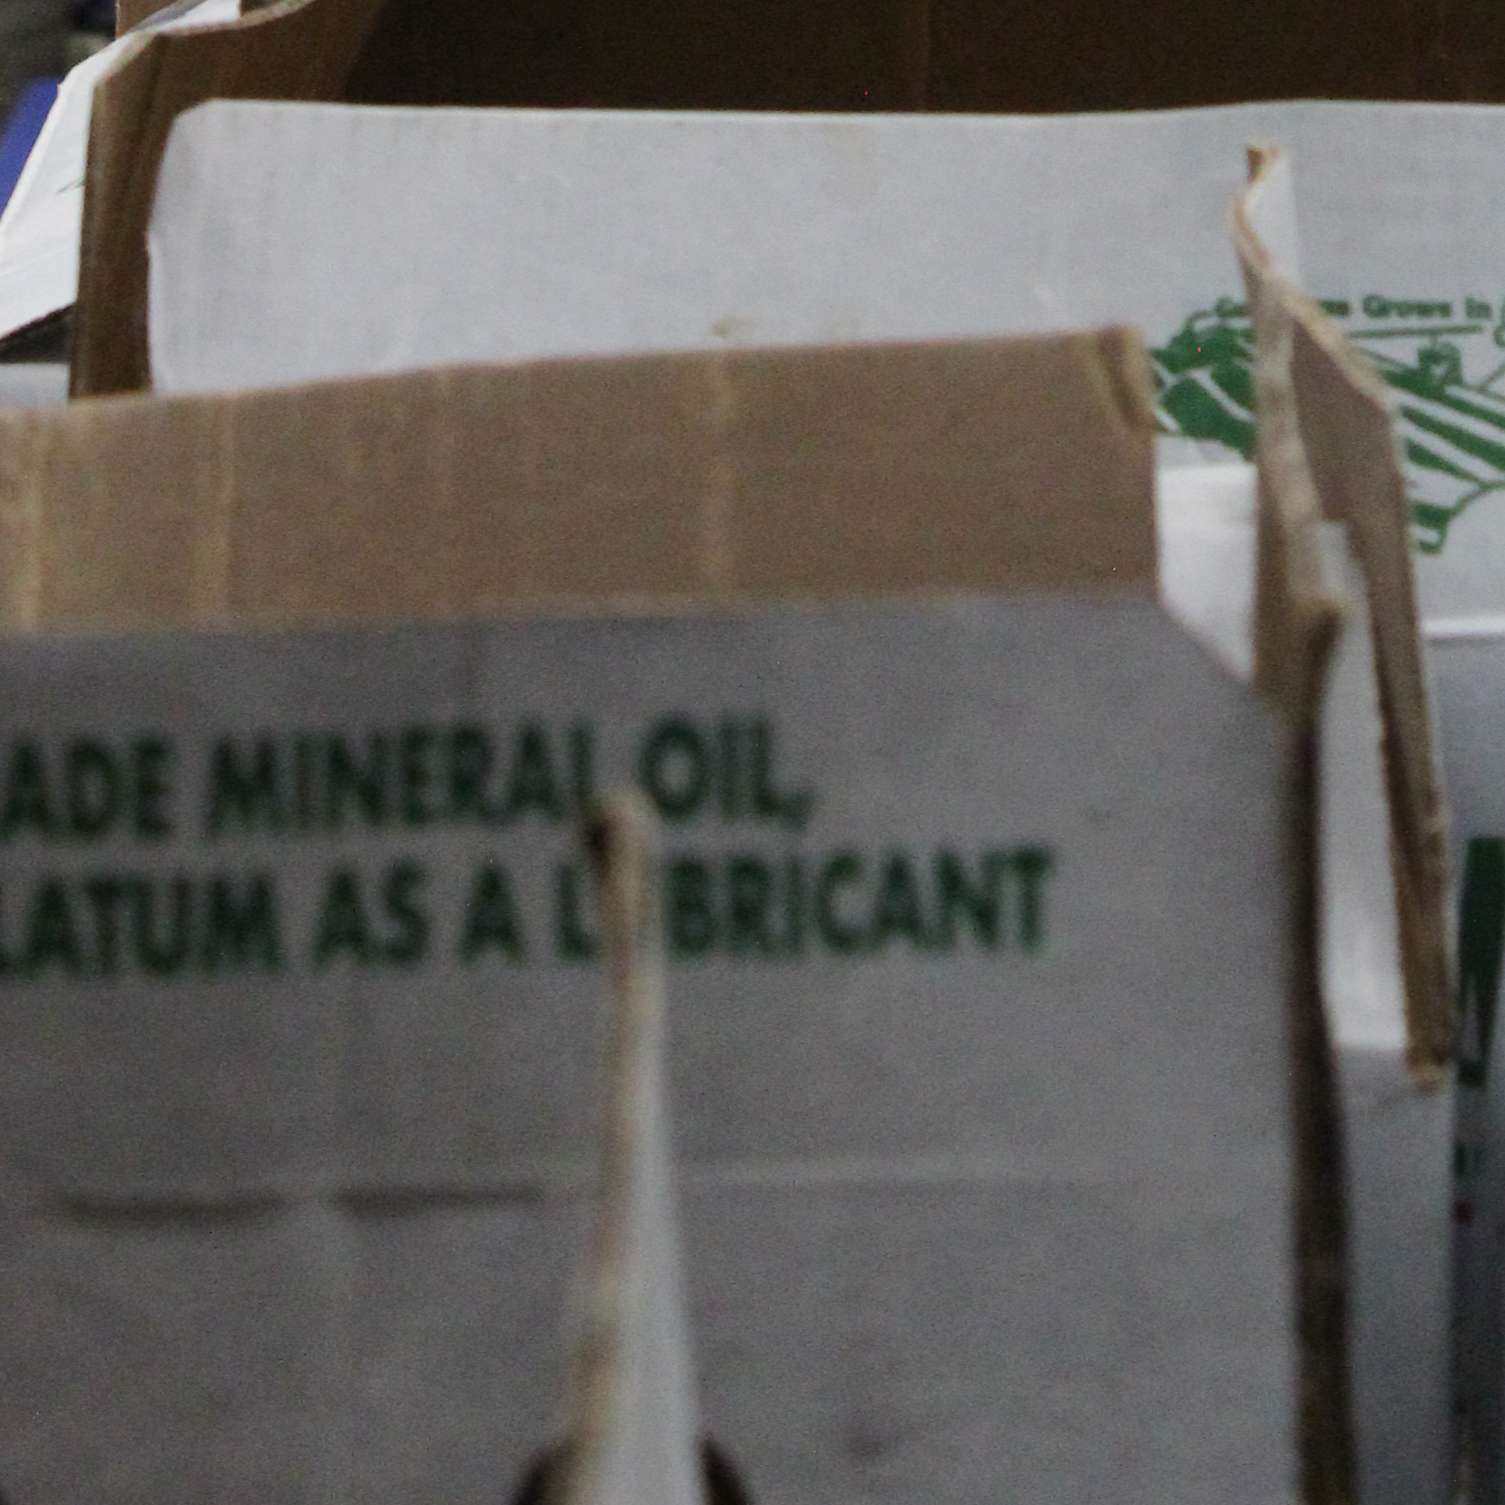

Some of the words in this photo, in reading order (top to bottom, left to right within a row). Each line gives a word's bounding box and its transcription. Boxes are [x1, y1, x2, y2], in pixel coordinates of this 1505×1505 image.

[312, 858, 430, 974] AS
[460, 858, 526, 968] A
[557, 842, 1050, 963] LBRICANT
